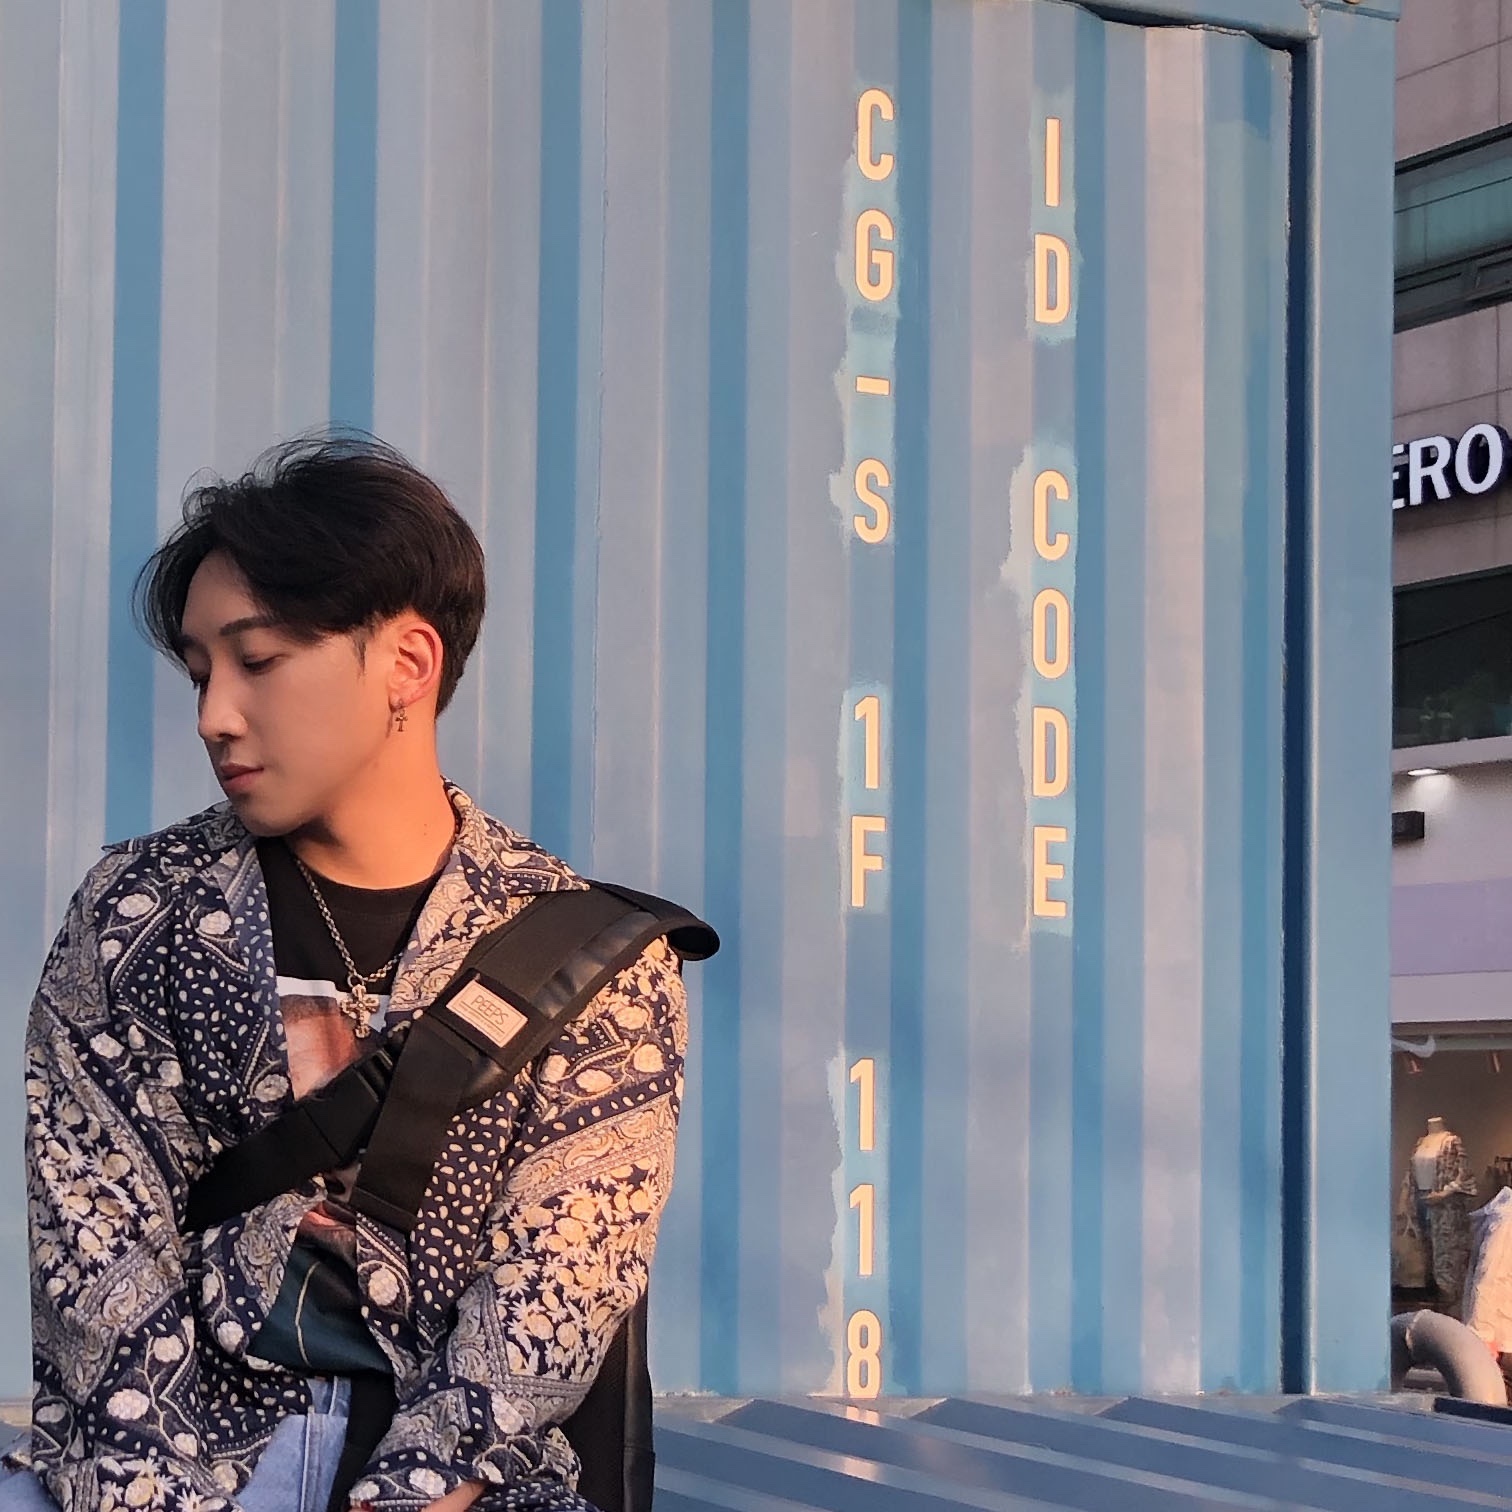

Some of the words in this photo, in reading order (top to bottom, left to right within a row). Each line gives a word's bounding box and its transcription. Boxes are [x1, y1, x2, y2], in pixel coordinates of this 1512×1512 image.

[854, 87, 896, 545] CG-S
[1033, 117, 1071, 325] ID
[851, 694, 887, 908] 1F
[1031, 469, 1071, 918] CODE
[471, 994, 509, 1026] PEEPS
[847, 1057, 882, 1398] 118
